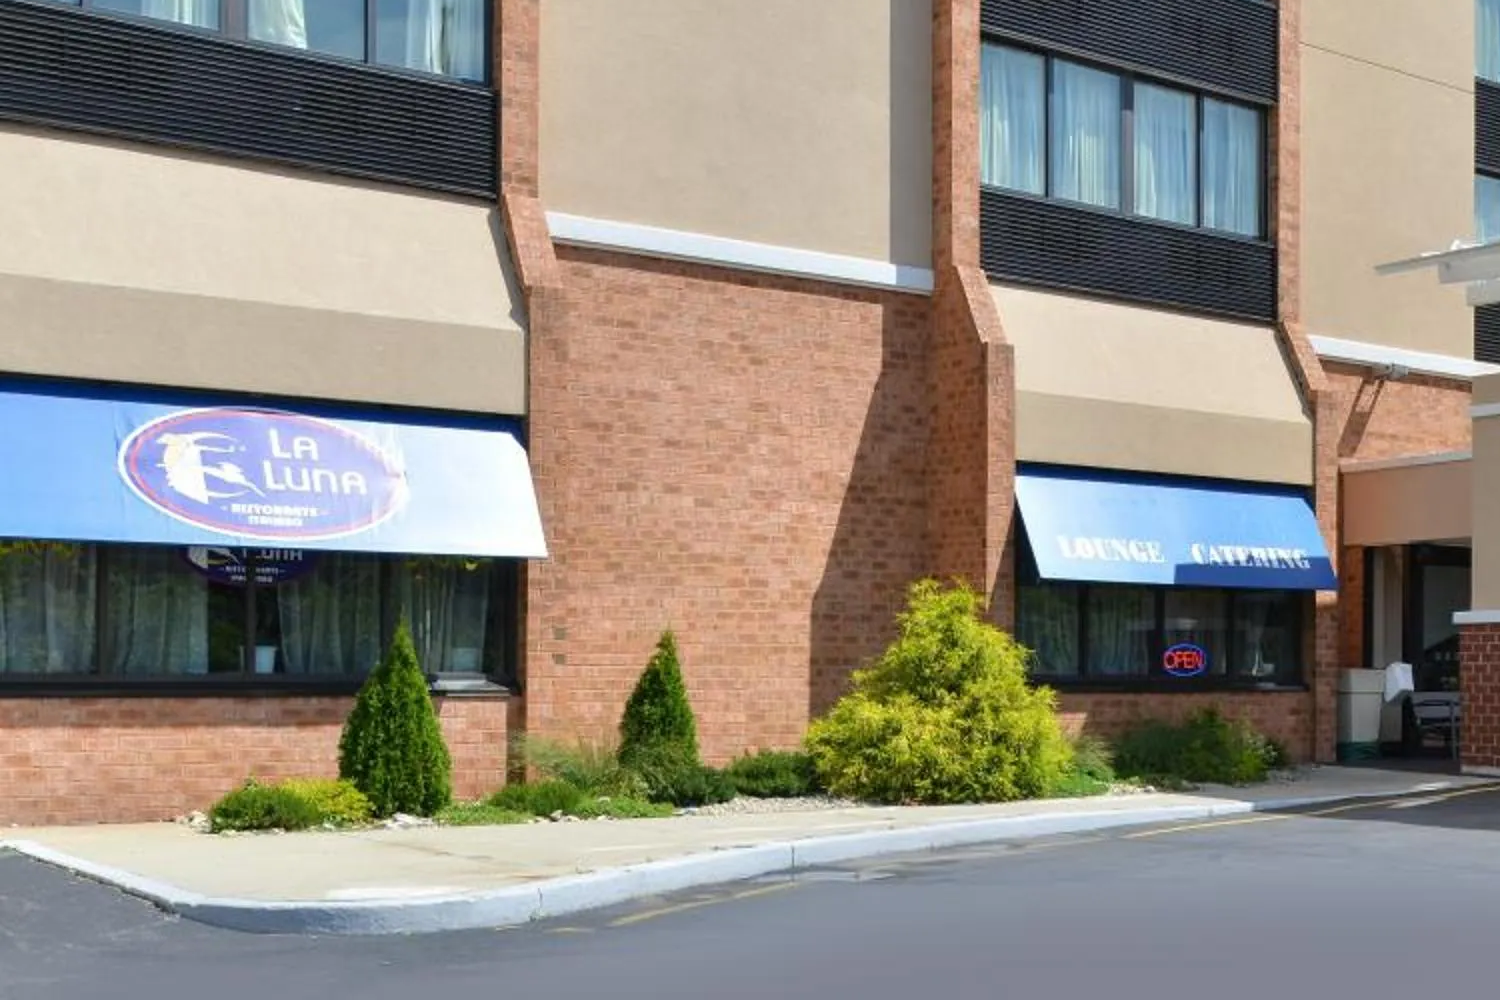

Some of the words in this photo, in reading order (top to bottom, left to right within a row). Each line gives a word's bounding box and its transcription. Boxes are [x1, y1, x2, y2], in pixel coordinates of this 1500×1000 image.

[269, 428, 319, 461] LA
[1056, 534, 1165, 564] LOUNGE
[1189, 542, 1312, 569] CATERING
[1163, 651, 1204, 669] OPEN
